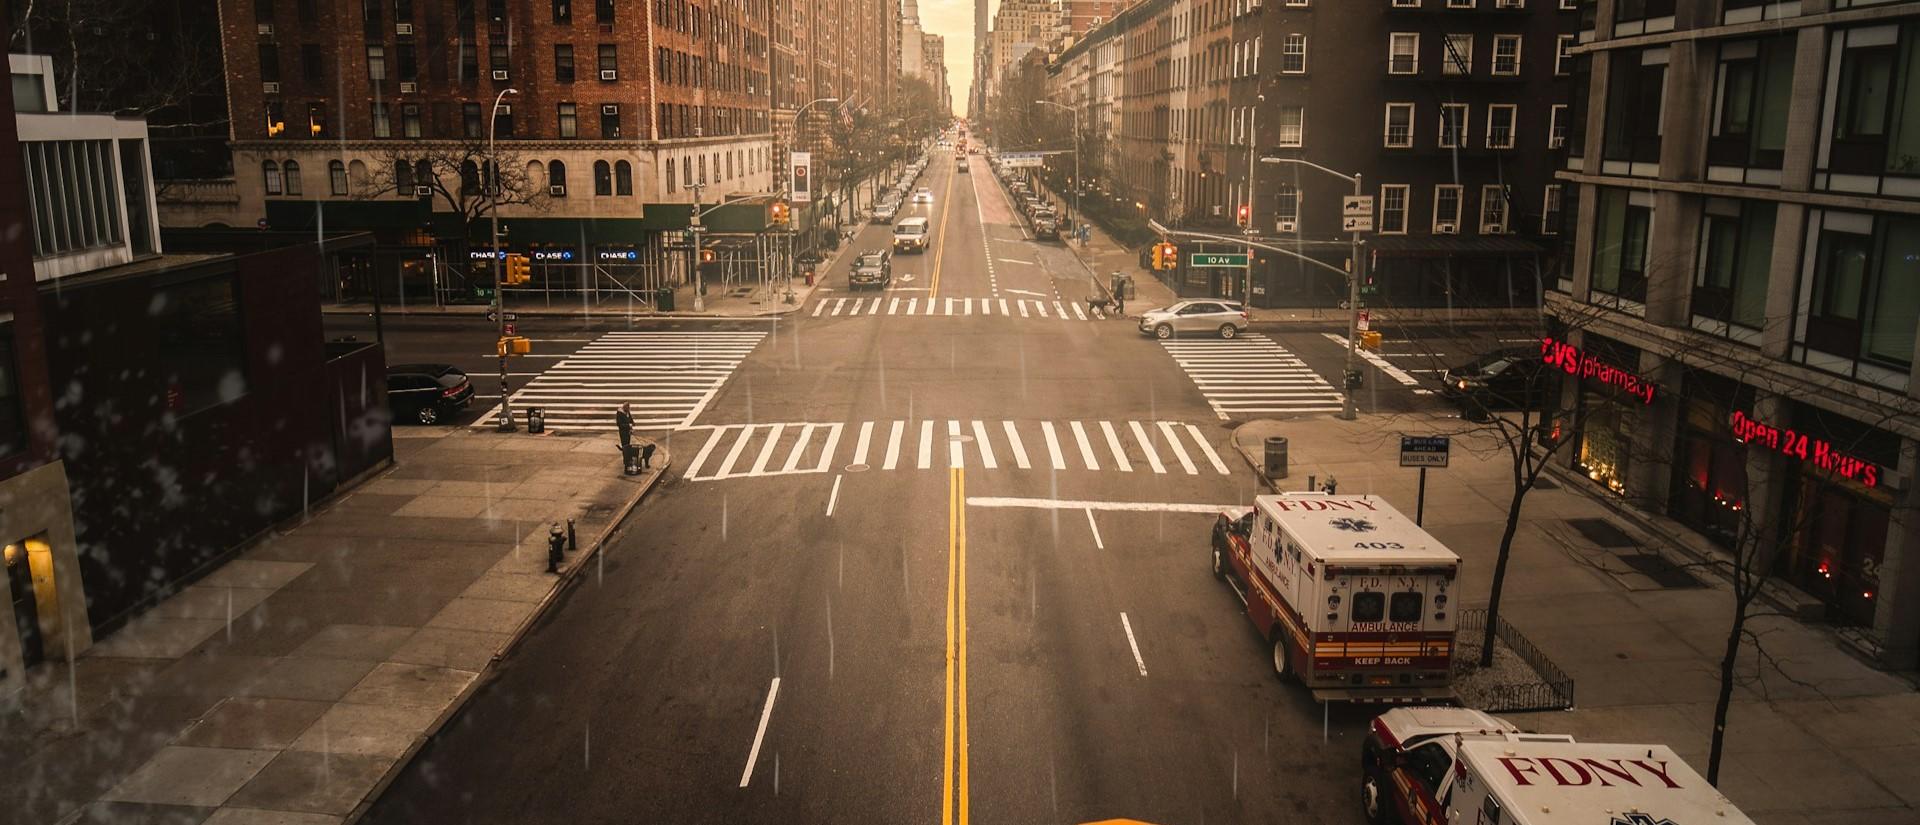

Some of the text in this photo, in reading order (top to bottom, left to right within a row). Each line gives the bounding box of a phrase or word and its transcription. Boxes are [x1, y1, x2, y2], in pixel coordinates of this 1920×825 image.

[1734, 410, 1876, 488] Open 24 Hours
[1276, 500, 1378, 511] FDNY
[1354, 542, 1405, 550] 403
[1352, 622, 1418, 632] AMBULANCE
[1495, 757, 1685, 790] FDNY
